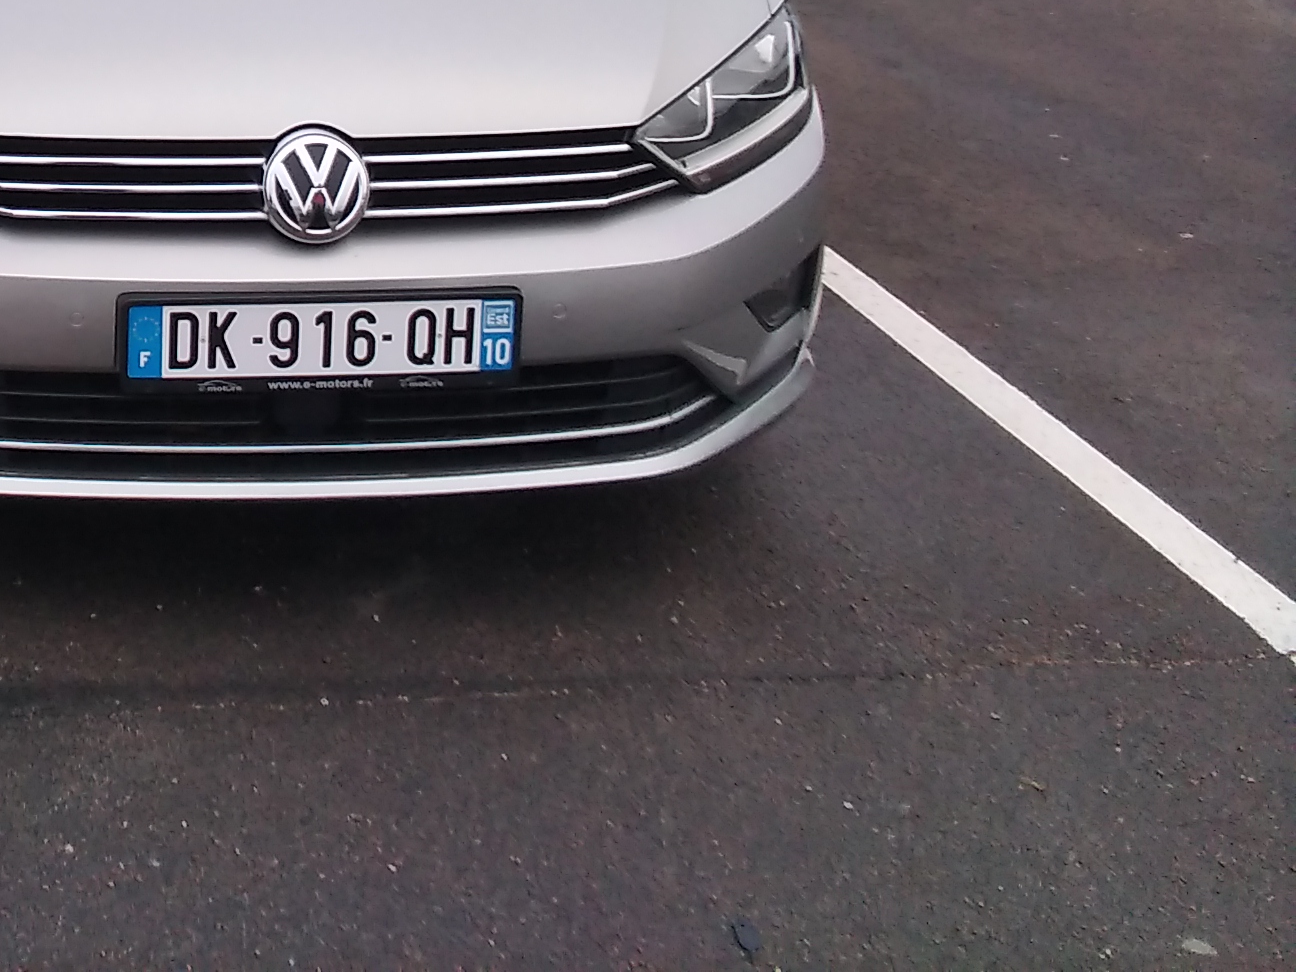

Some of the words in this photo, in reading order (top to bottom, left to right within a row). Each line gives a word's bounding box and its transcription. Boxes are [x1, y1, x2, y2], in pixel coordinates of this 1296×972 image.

[486, 313, 510, 326] Est
[138, 350, 152, 368] F
[483, 337, 512, 366] 10
[267, 377, 374, 390] www.e-motors.fr
